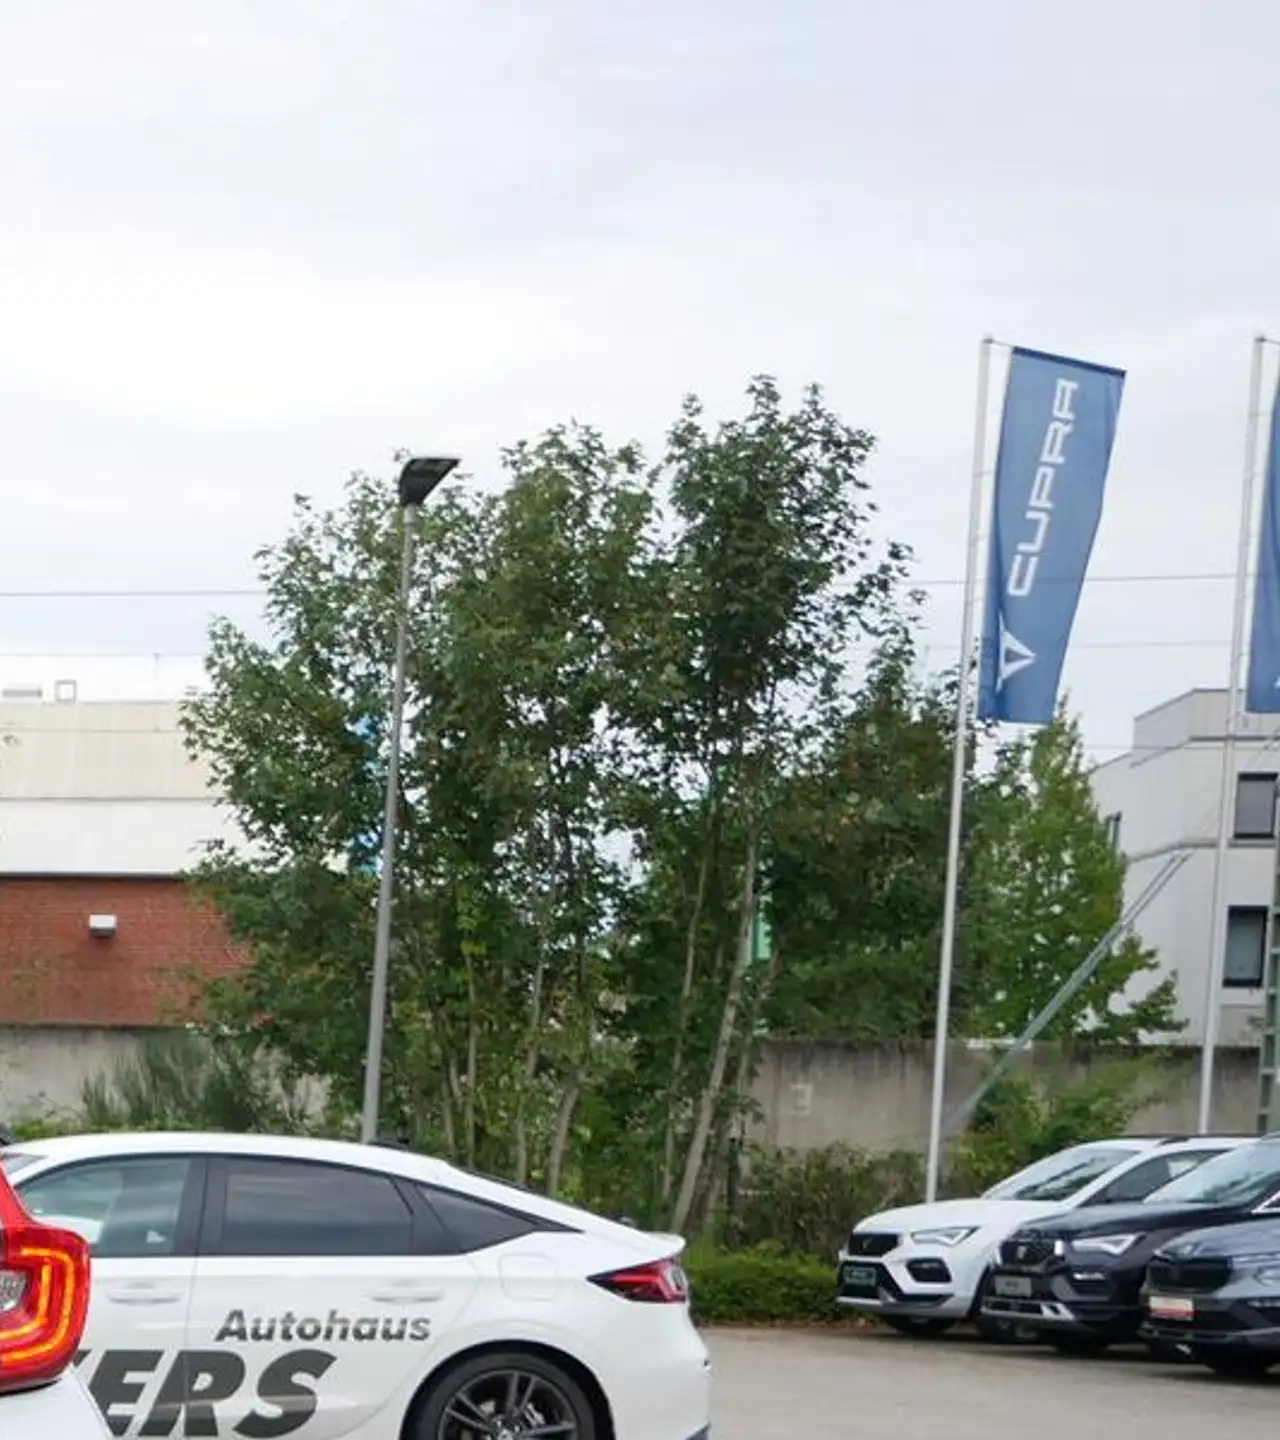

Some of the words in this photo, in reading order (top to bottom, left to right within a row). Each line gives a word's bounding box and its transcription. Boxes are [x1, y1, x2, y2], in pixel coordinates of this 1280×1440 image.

[1007, 377, 1079, 598] CUPRA
[215, 1309, 431, 1342] Autohaus
[72, 1349, 338, 1439] ERS
